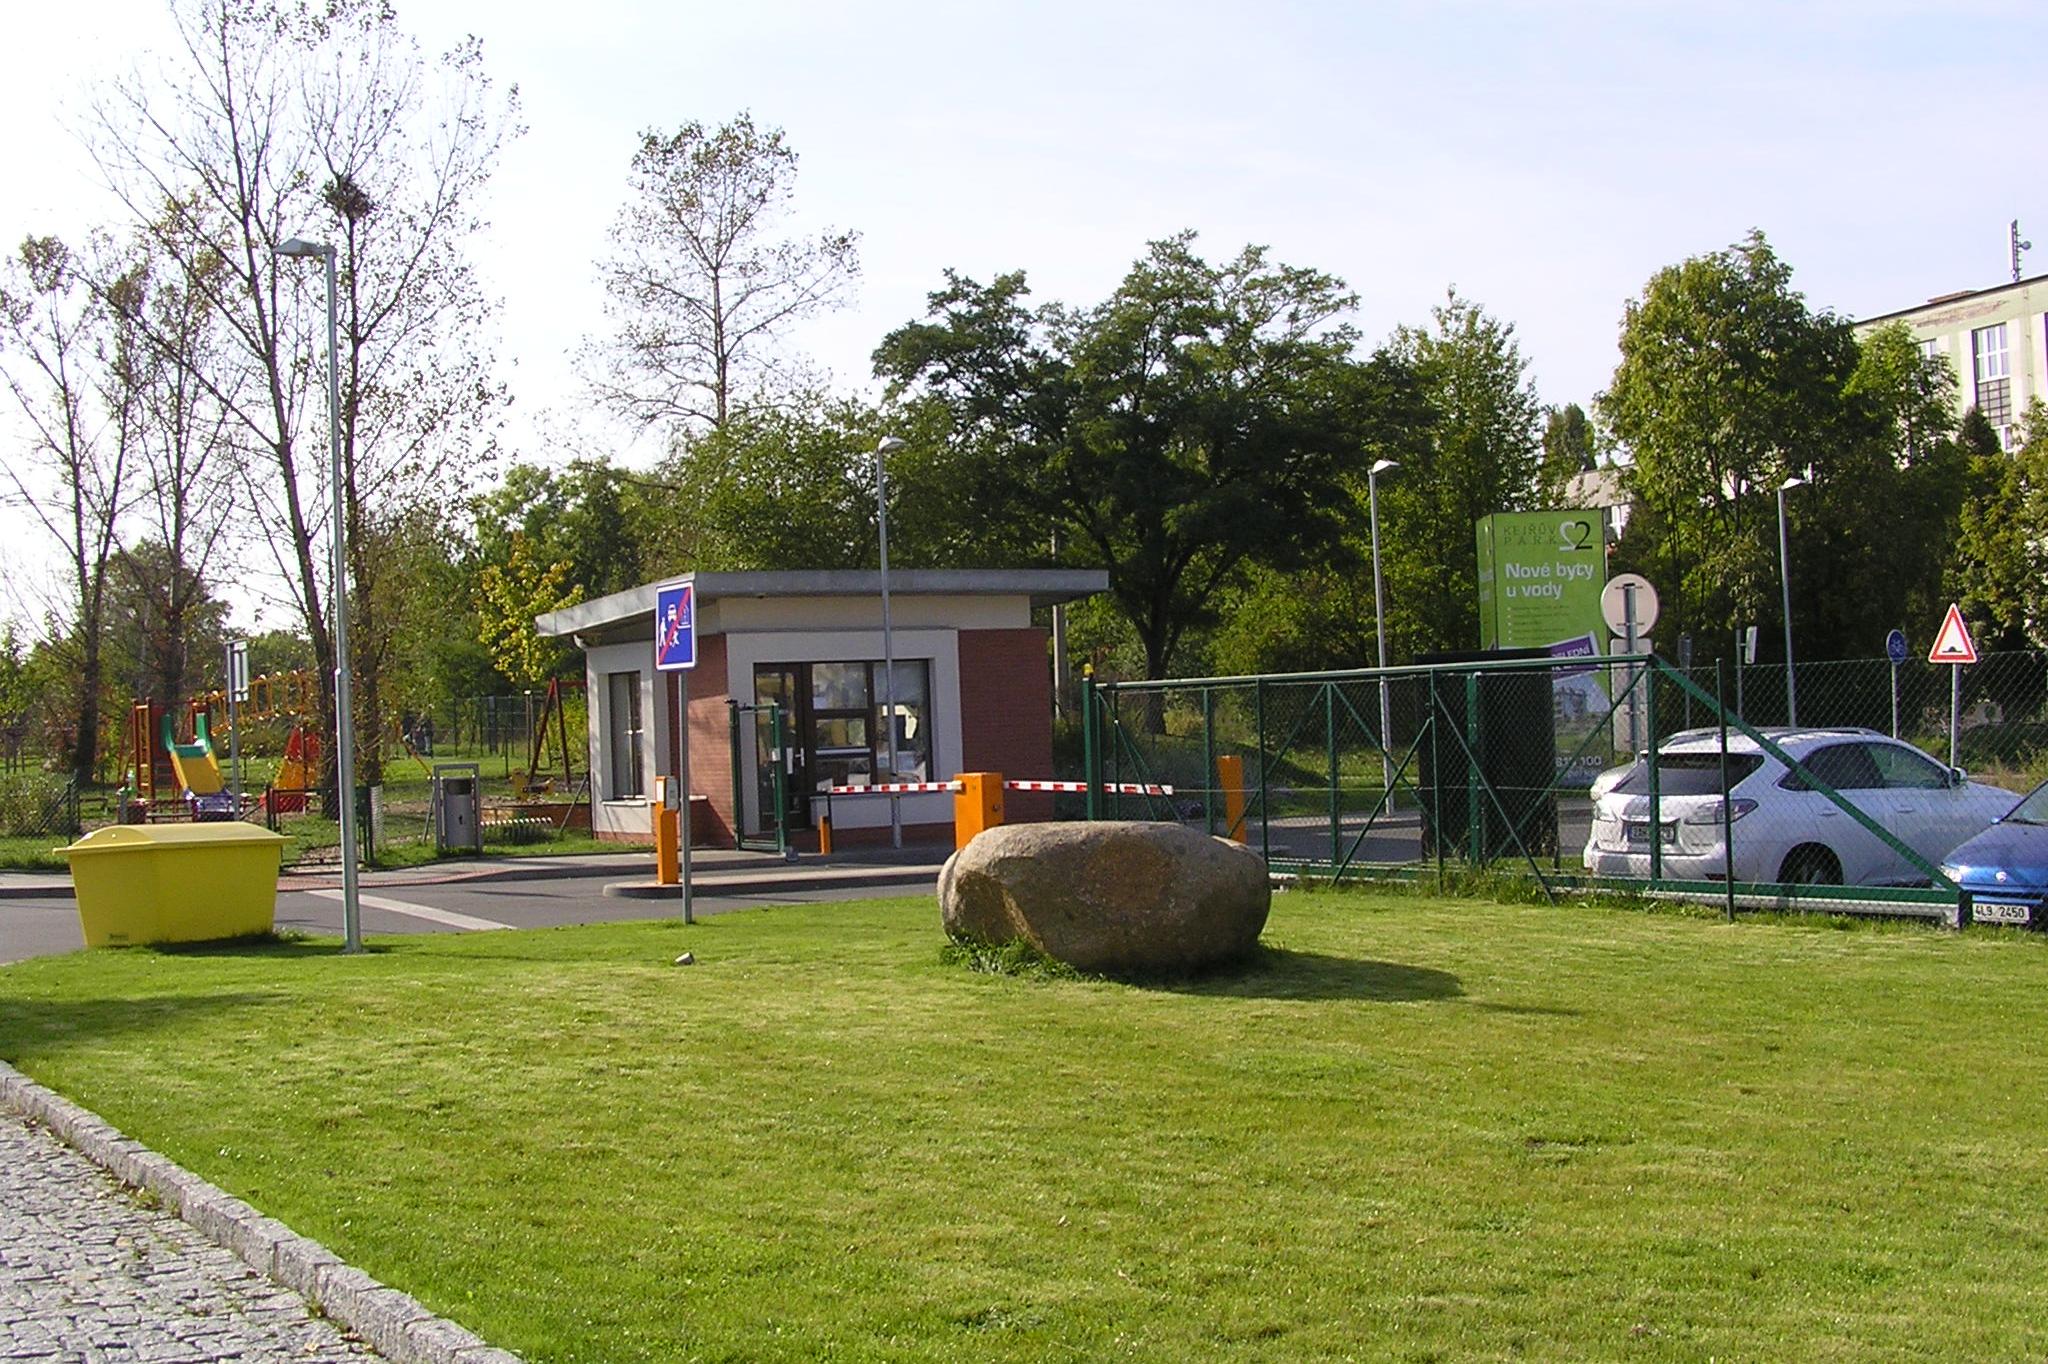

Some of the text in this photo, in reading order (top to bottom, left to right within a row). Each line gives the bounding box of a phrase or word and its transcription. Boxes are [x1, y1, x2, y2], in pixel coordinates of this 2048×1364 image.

[1504, 535, 1557, 545] PARK
[1505, 562, 1551, 579] Nové
[1556, 561, 1594, 581] byty
[1506, 586, 1517, 598] u
[1521, 581, 1563, 600] vody
[1999, 906, 2025, 919] 2450
